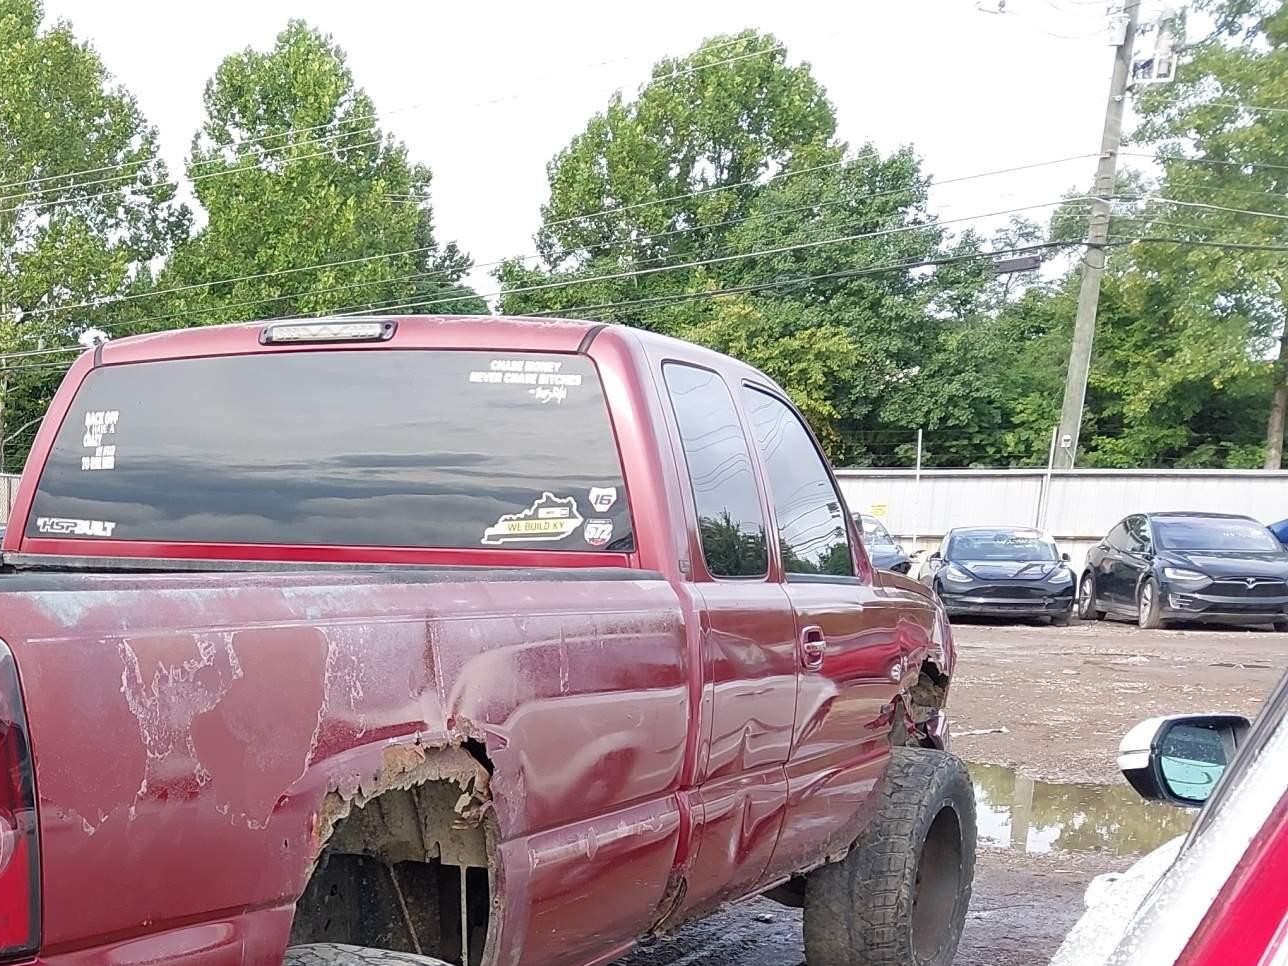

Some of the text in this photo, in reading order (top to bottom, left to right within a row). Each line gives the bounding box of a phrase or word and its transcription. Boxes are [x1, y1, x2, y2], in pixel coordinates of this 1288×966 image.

[594, 494, 614, 506] 16
[507, 521, 565, 532] WE BUILD KY
[584, 524, 612, 539] 572
